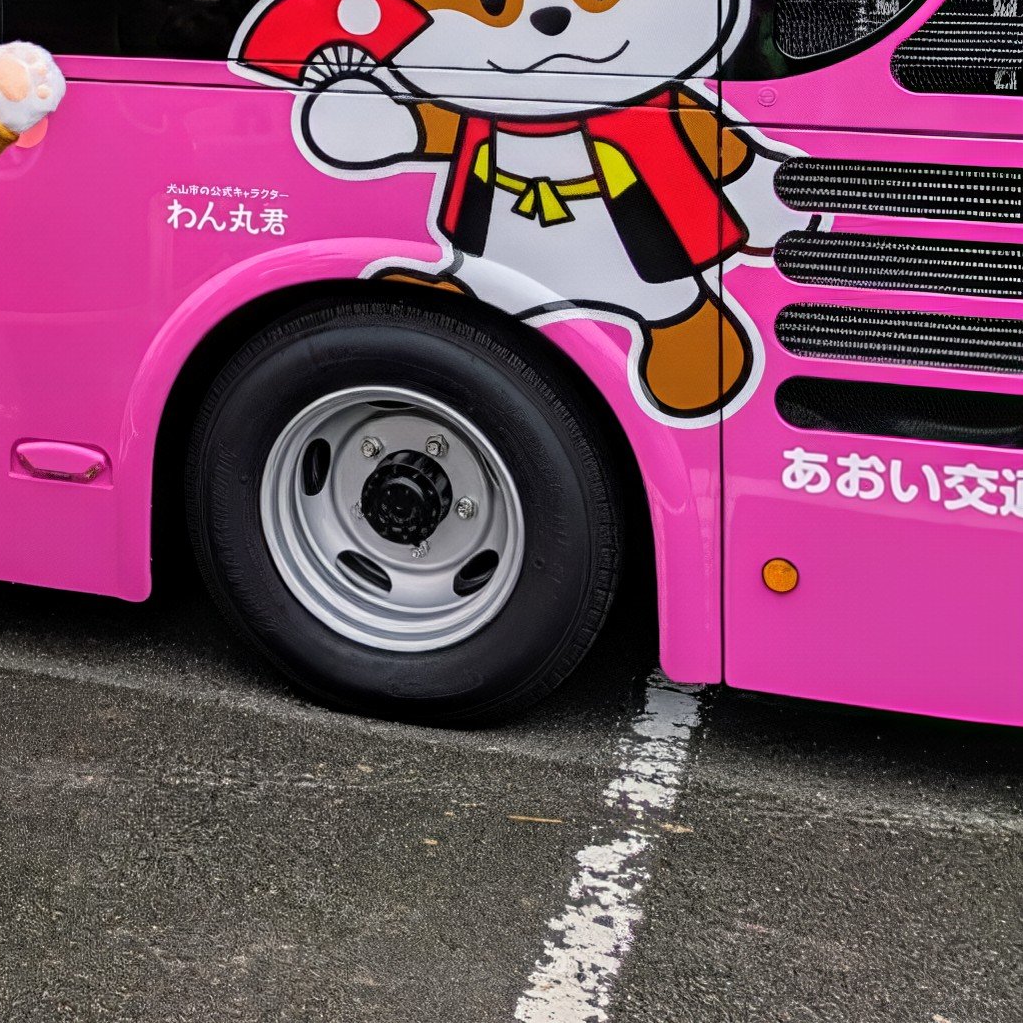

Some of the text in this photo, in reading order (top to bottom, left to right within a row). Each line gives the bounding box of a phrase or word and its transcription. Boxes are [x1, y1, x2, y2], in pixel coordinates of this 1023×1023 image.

[166, 183, 290, 200] 犬山市の公式キャラクター
[166, 198, 289, 236] わん丸君
